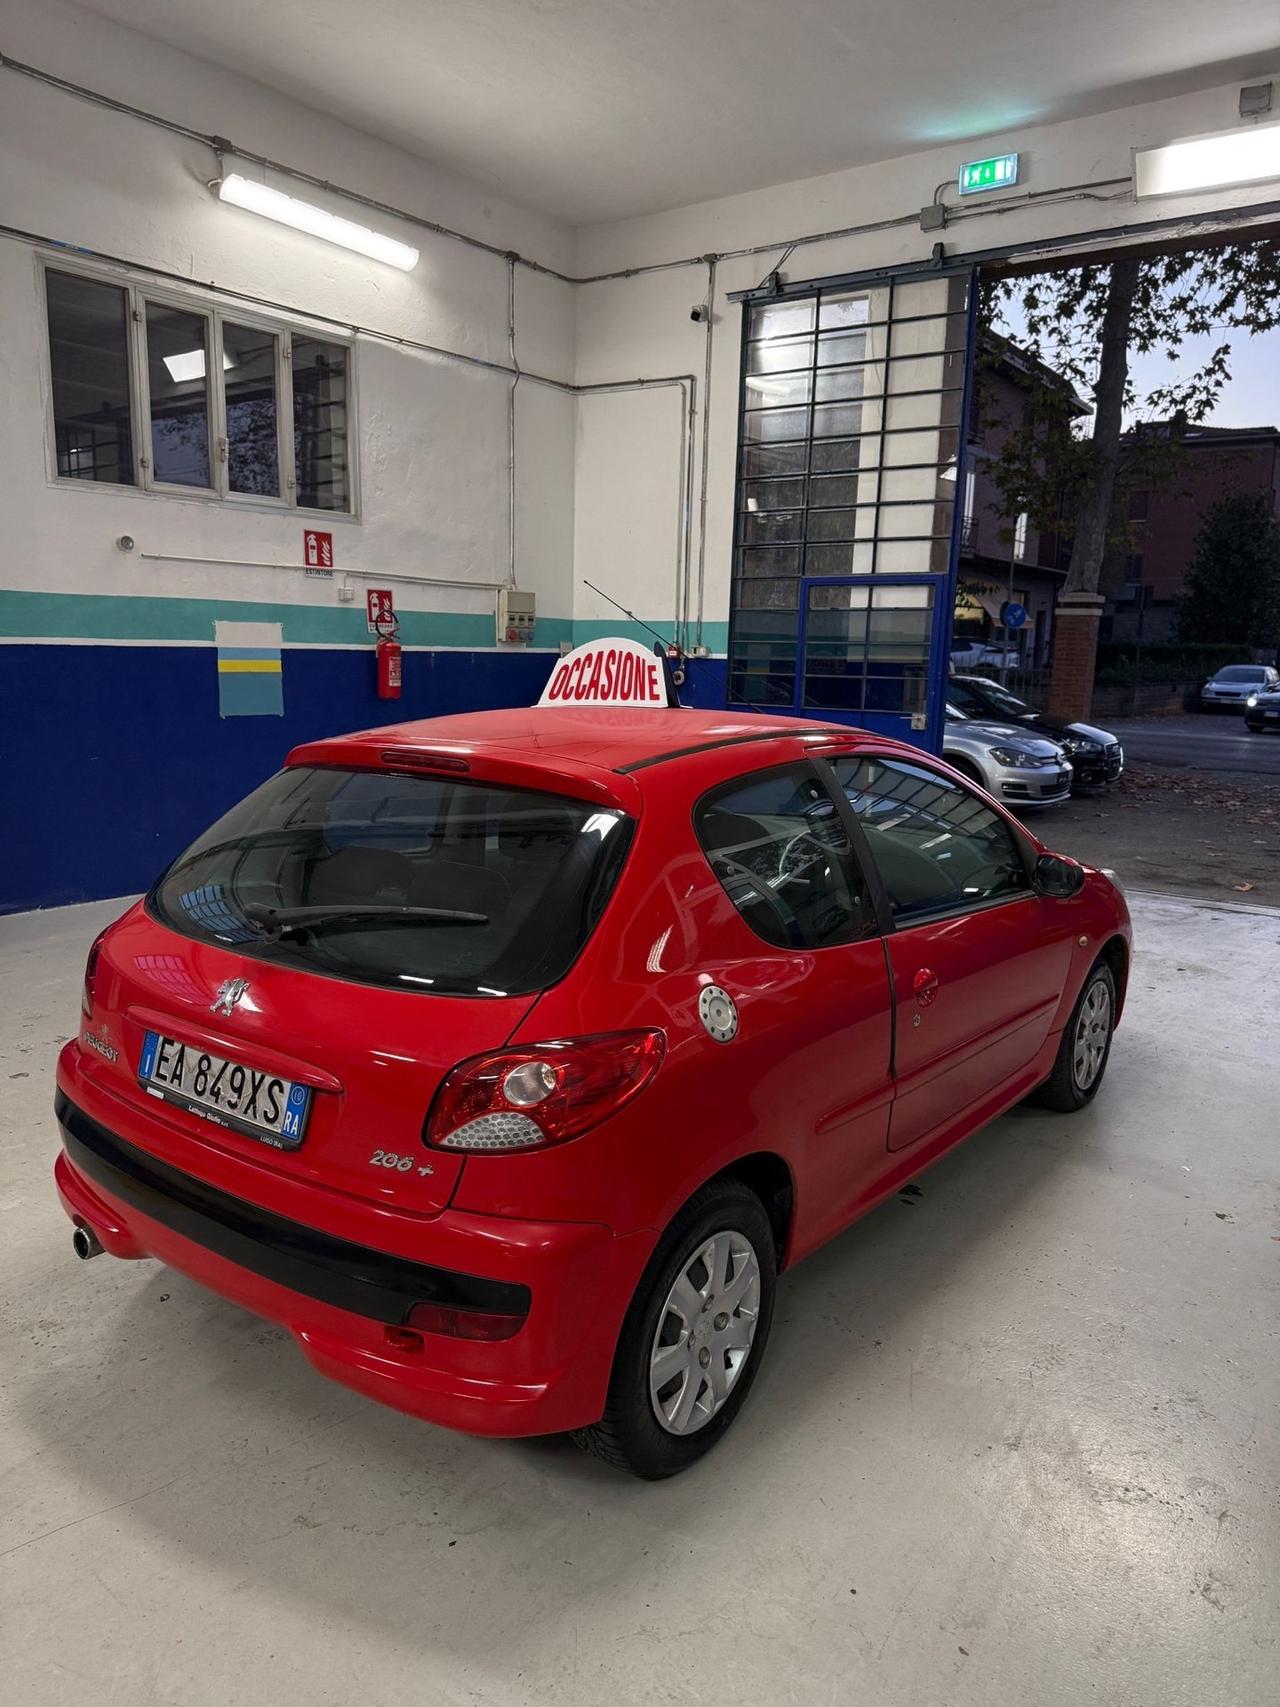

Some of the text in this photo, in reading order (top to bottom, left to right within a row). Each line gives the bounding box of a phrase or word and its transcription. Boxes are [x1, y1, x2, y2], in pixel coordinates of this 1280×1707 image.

[305, 567, 333, 577] ESTINTORE
[548, 649, 660, 701] OCCASIONE
[155, 1037, 284, 1125] EA 849XS
[283, 1111, 299, 1135] RA
[369, 1149, 414, 1172] 206
